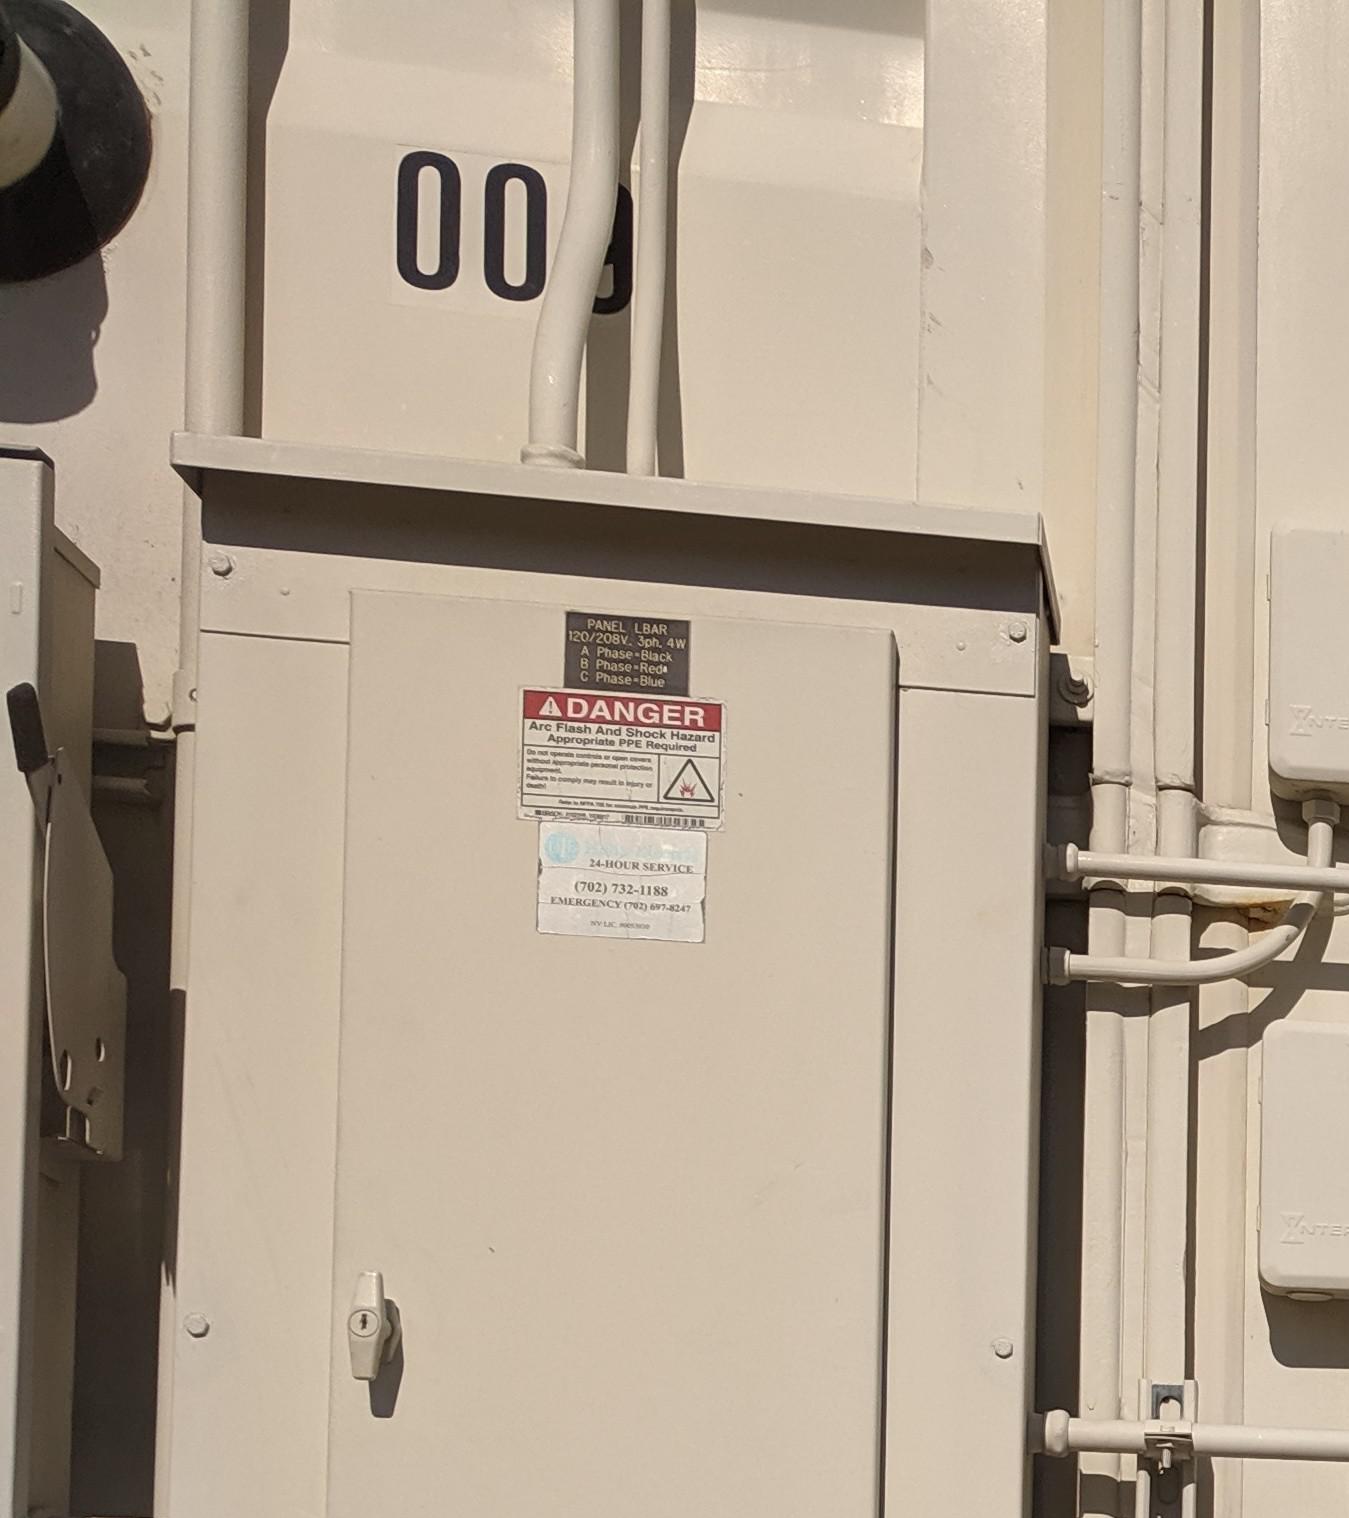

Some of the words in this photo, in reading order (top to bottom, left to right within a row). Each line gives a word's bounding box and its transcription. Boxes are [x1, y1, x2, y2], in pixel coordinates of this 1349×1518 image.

[587, 619, 626, 632] PANEL
[634, 622, 668, 635] LBAR
[581, 645, 589, 656] A
[667, 637, 686, 649] 4W
[580, 657, 589, 669] B
[580, 671, 589, 682] C
[567, 697, 705, 727] DANGER
[529, 721, 552, 732] Arc
[556, 722, 592, 735] Flash
[596, 725, 621, 737] And
[626, 727, 666, 740] Shock
[671, 731, 715, 743] Hazard
[547, 734, 615, 747] Appropriate
[619, 738, 641, 748] PPE
[646, 740, 697, 752] Required
[589, 858, 640, 871] 24-HOUR
[642, 861, 694, 873] SERVICE
[574, 881, 608, 894] (702)
[612, 883, 669, 897] 732-1188
[550, 896, 622, 909] EMERGENCY
[624, 901, 648, 912] (702)
